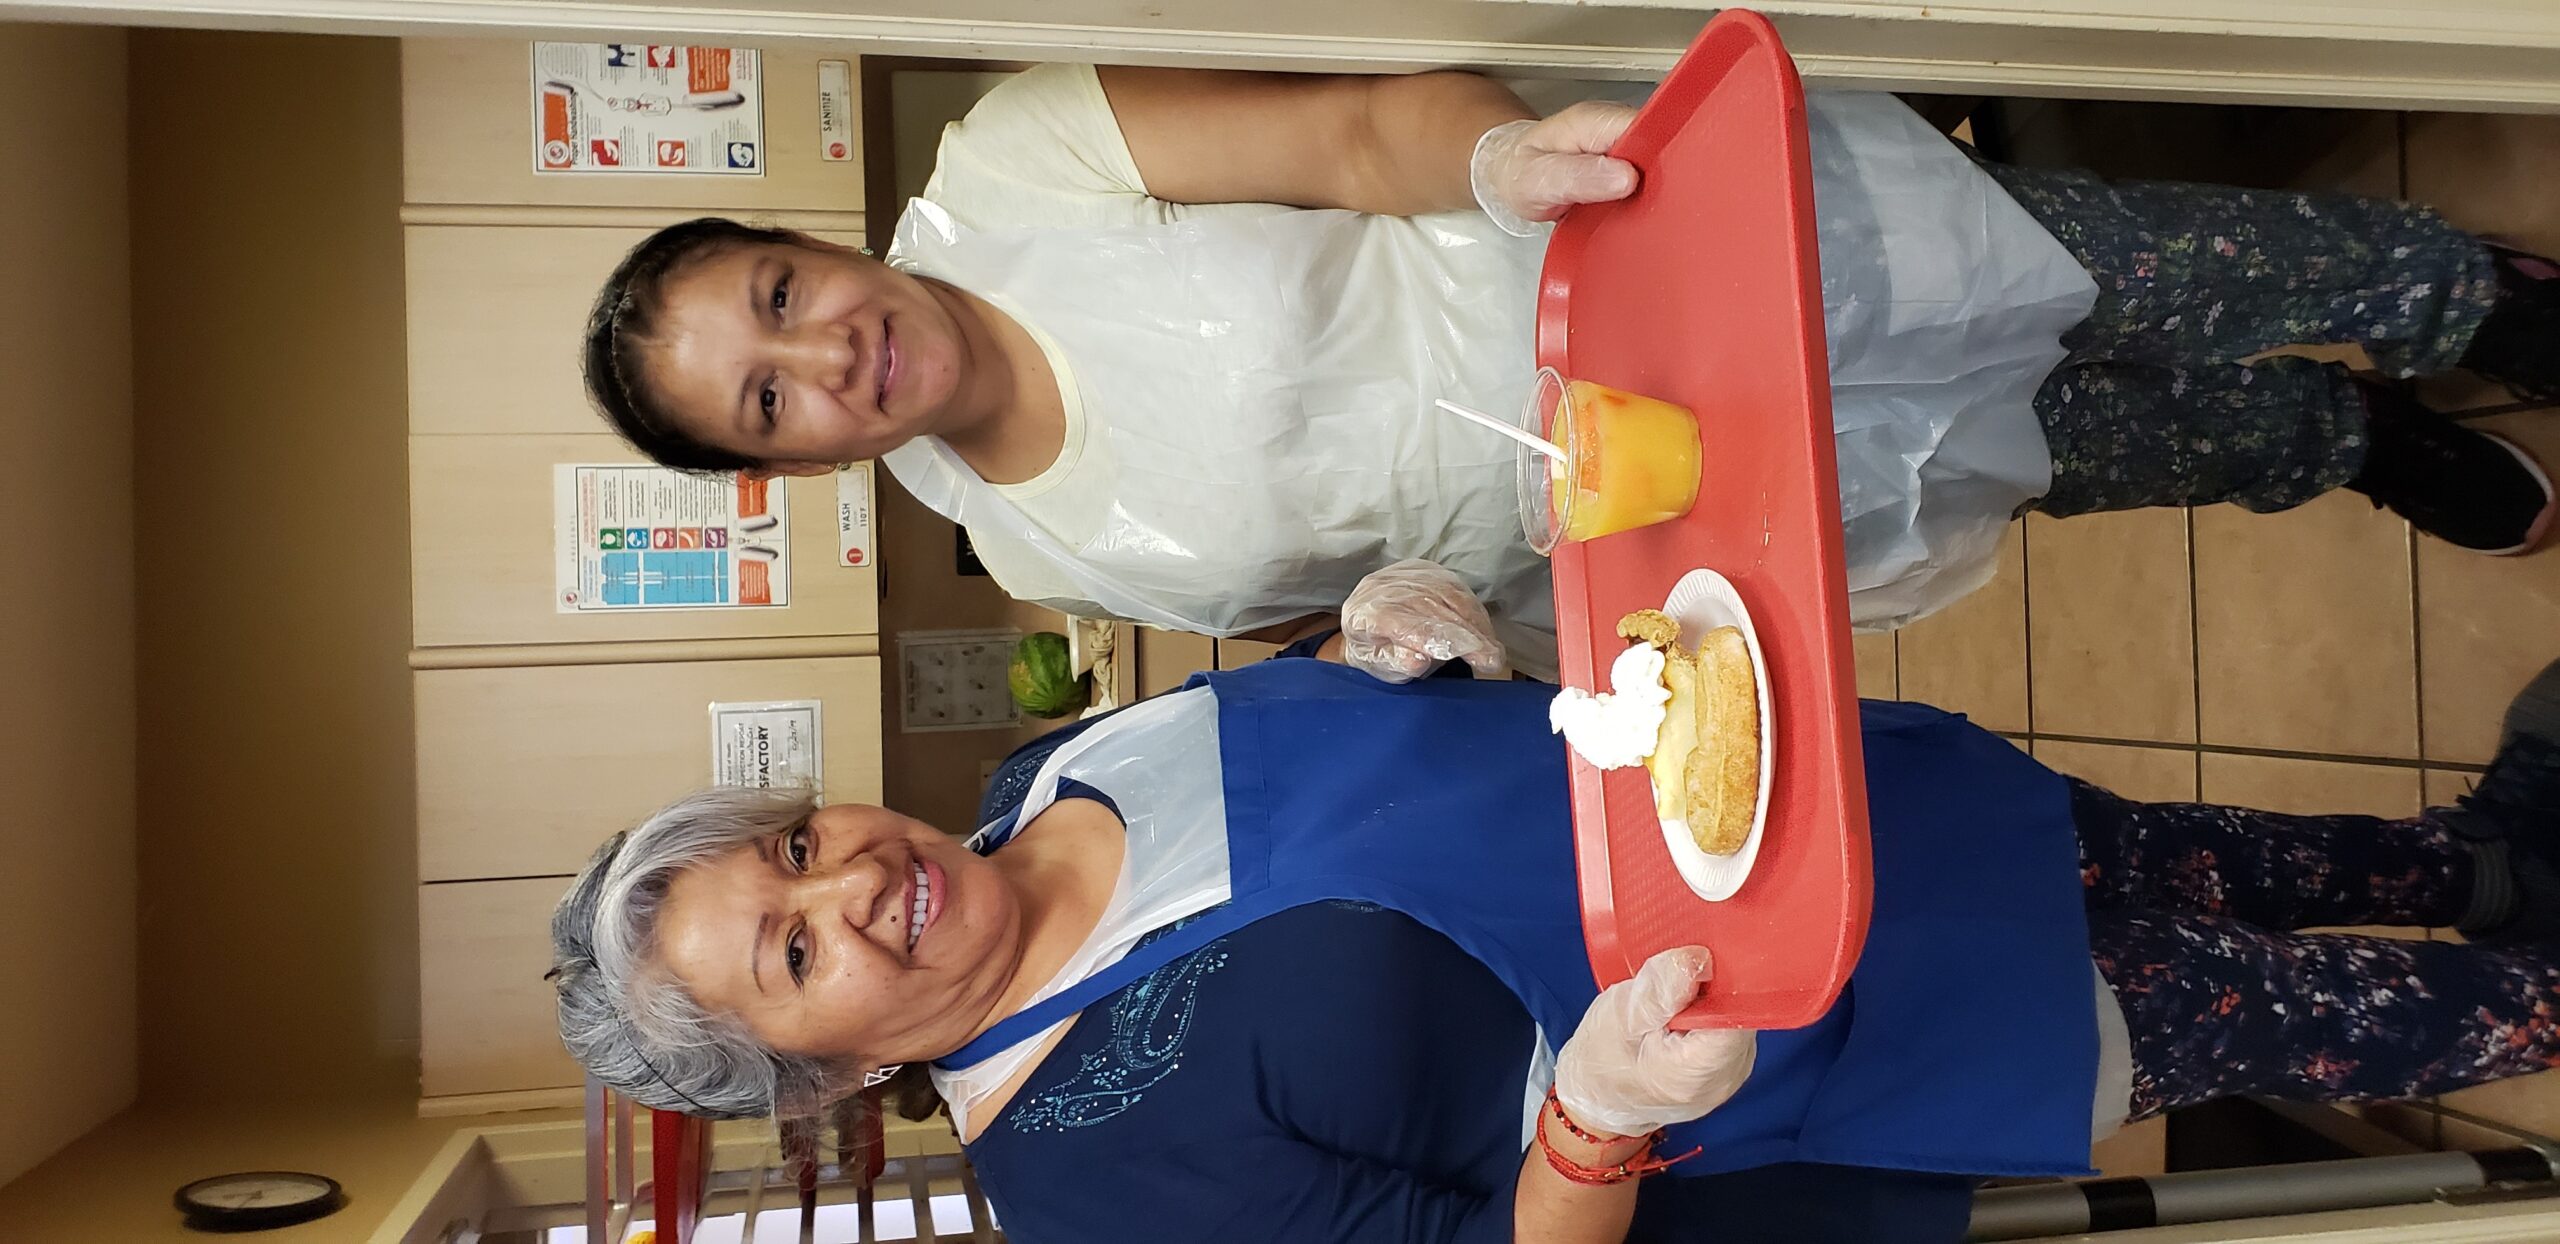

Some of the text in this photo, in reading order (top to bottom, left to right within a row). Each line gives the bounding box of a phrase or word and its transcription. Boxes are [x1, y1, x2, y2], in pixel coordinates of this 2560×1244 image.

[822, 91, 831, 131] SANITIZE
[571, 141, 580, 165] Proper
[842, 503, 851, 532] WASH
[758, 726, 770, 788] SFACTORY
